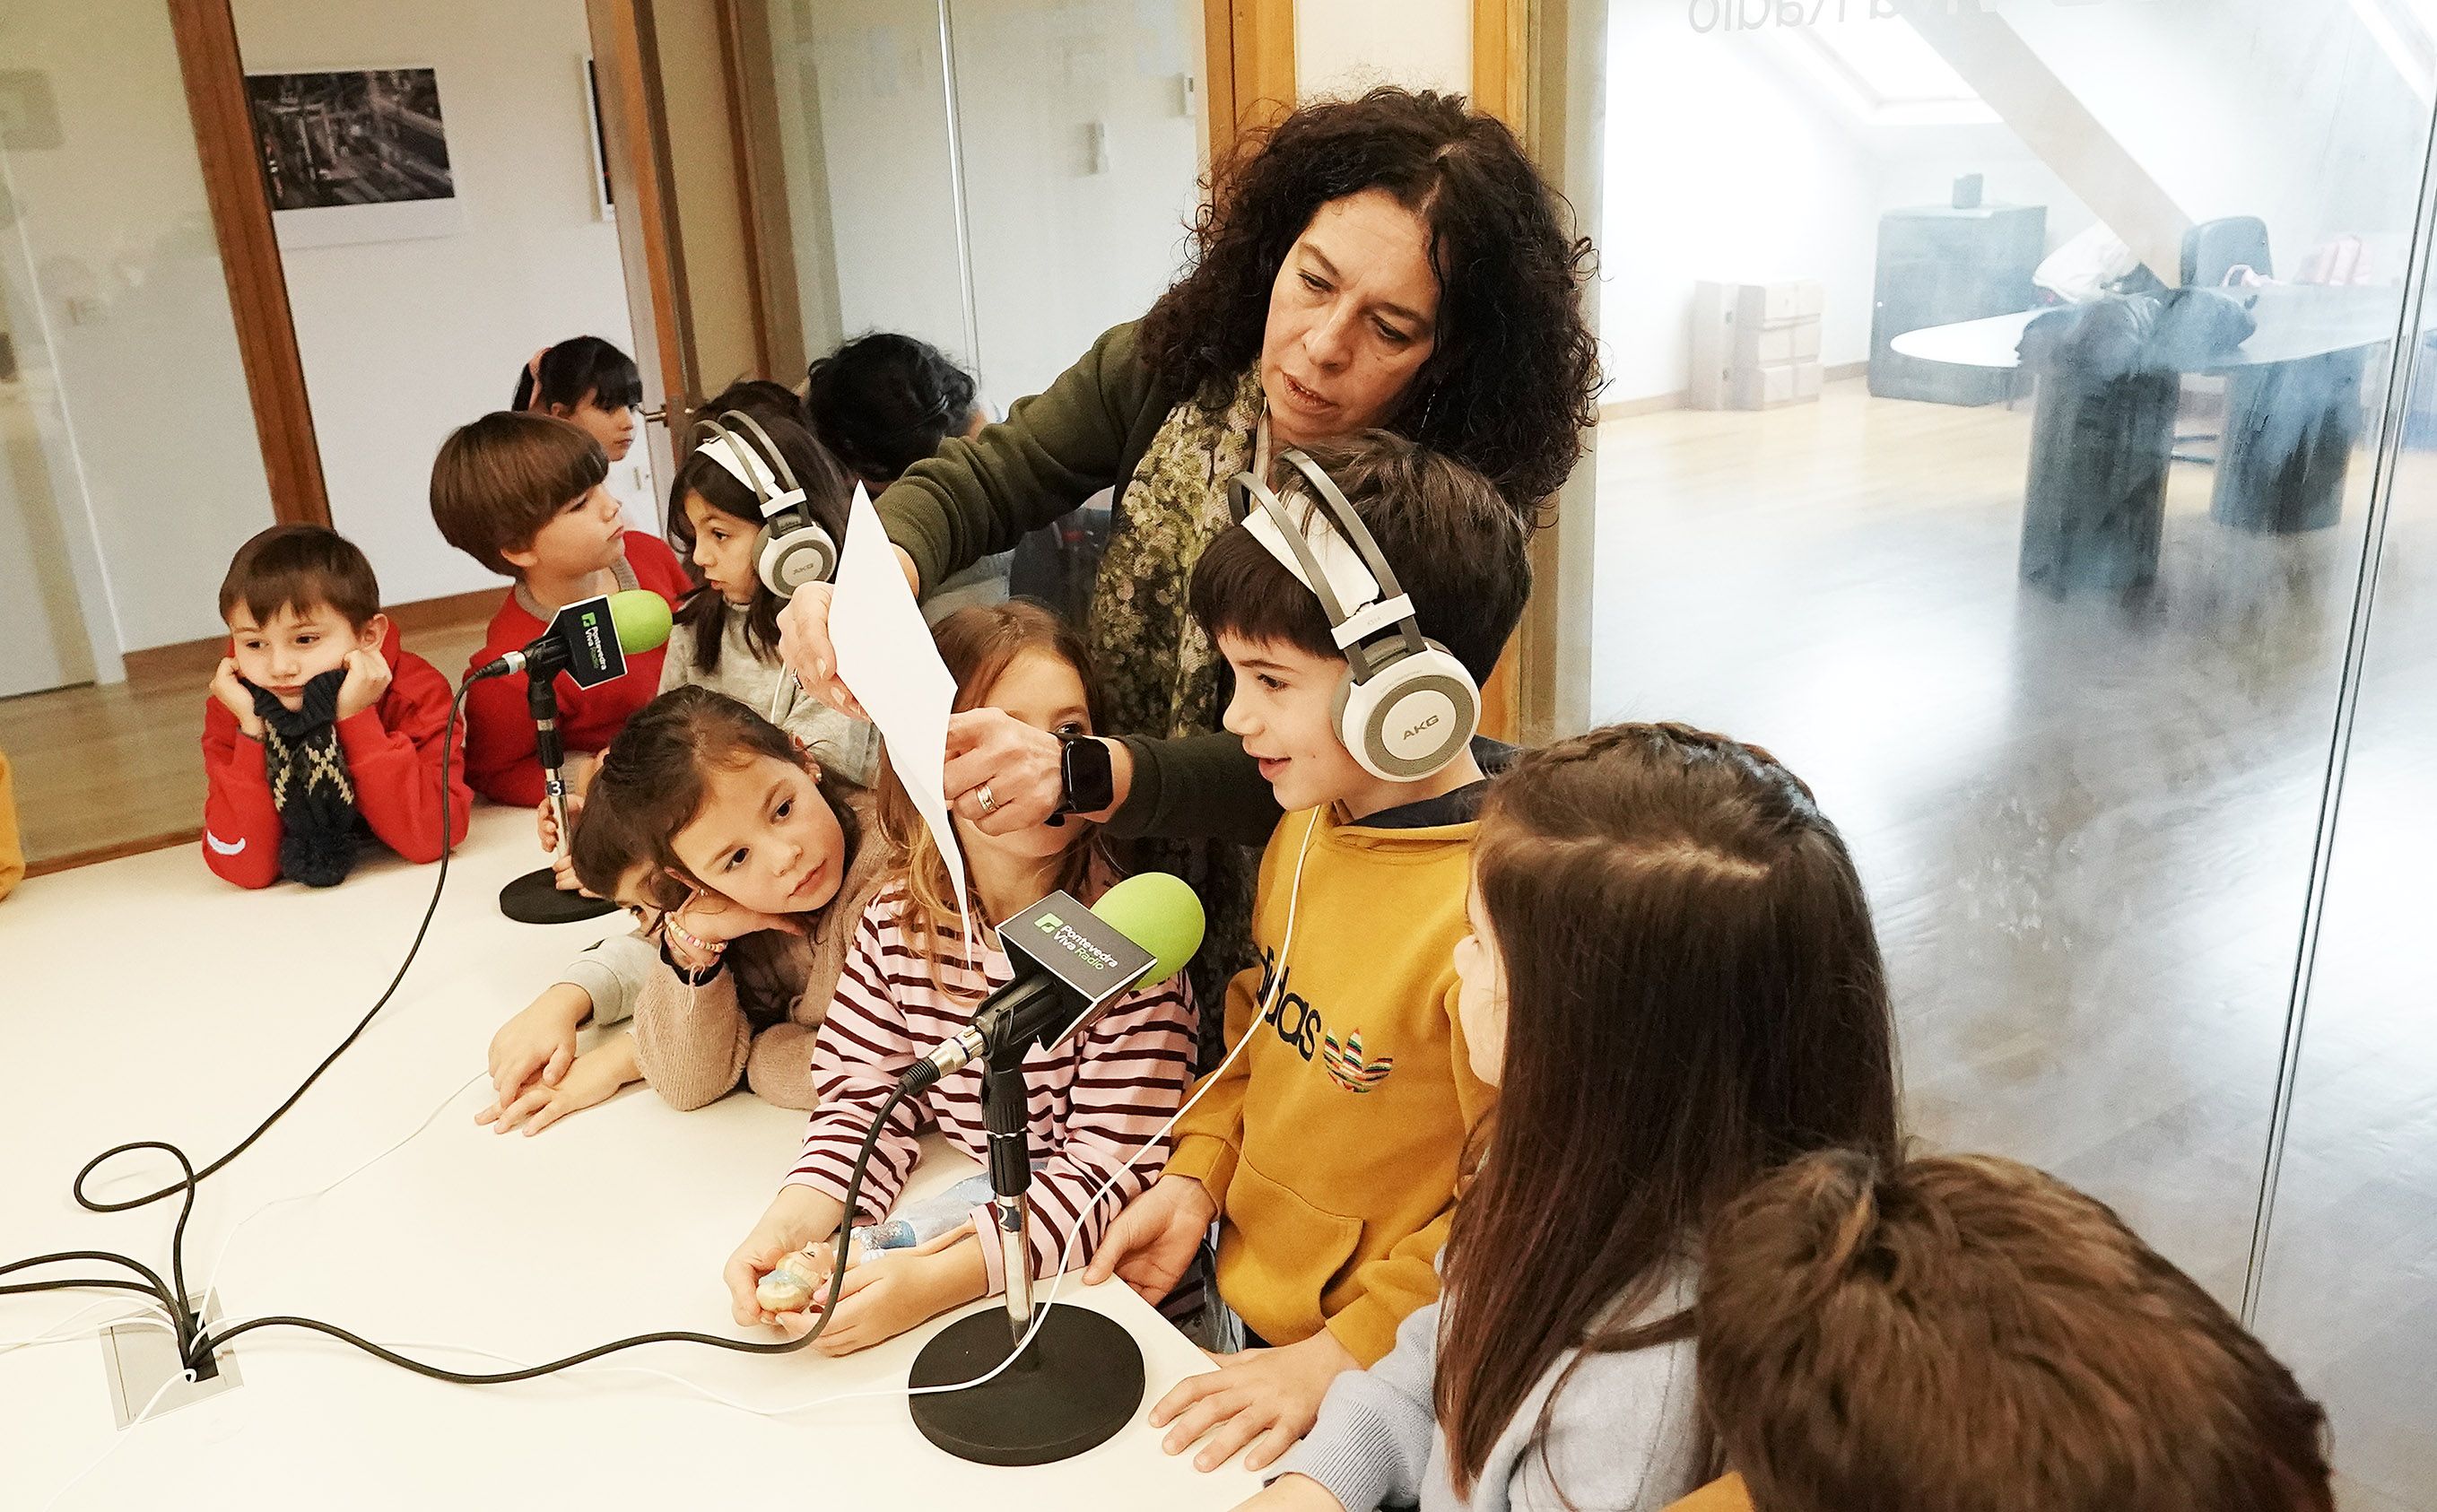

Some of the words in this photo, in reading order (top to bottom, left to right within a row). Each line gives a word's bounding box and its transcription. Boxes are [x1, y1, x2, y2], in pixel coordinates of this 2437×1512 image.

[585, 628, 594, 647] Viva
[591, 626, 607, 671] Pontevedra
[1402, 714, 1440, 741] AKG
[551, 780, 562, 796] 3
[1053, 930, 1077, 952] Viva
[1074, 947, 1105, 970] Radio
[1059, 924, 1119, 969] Pontevedra
